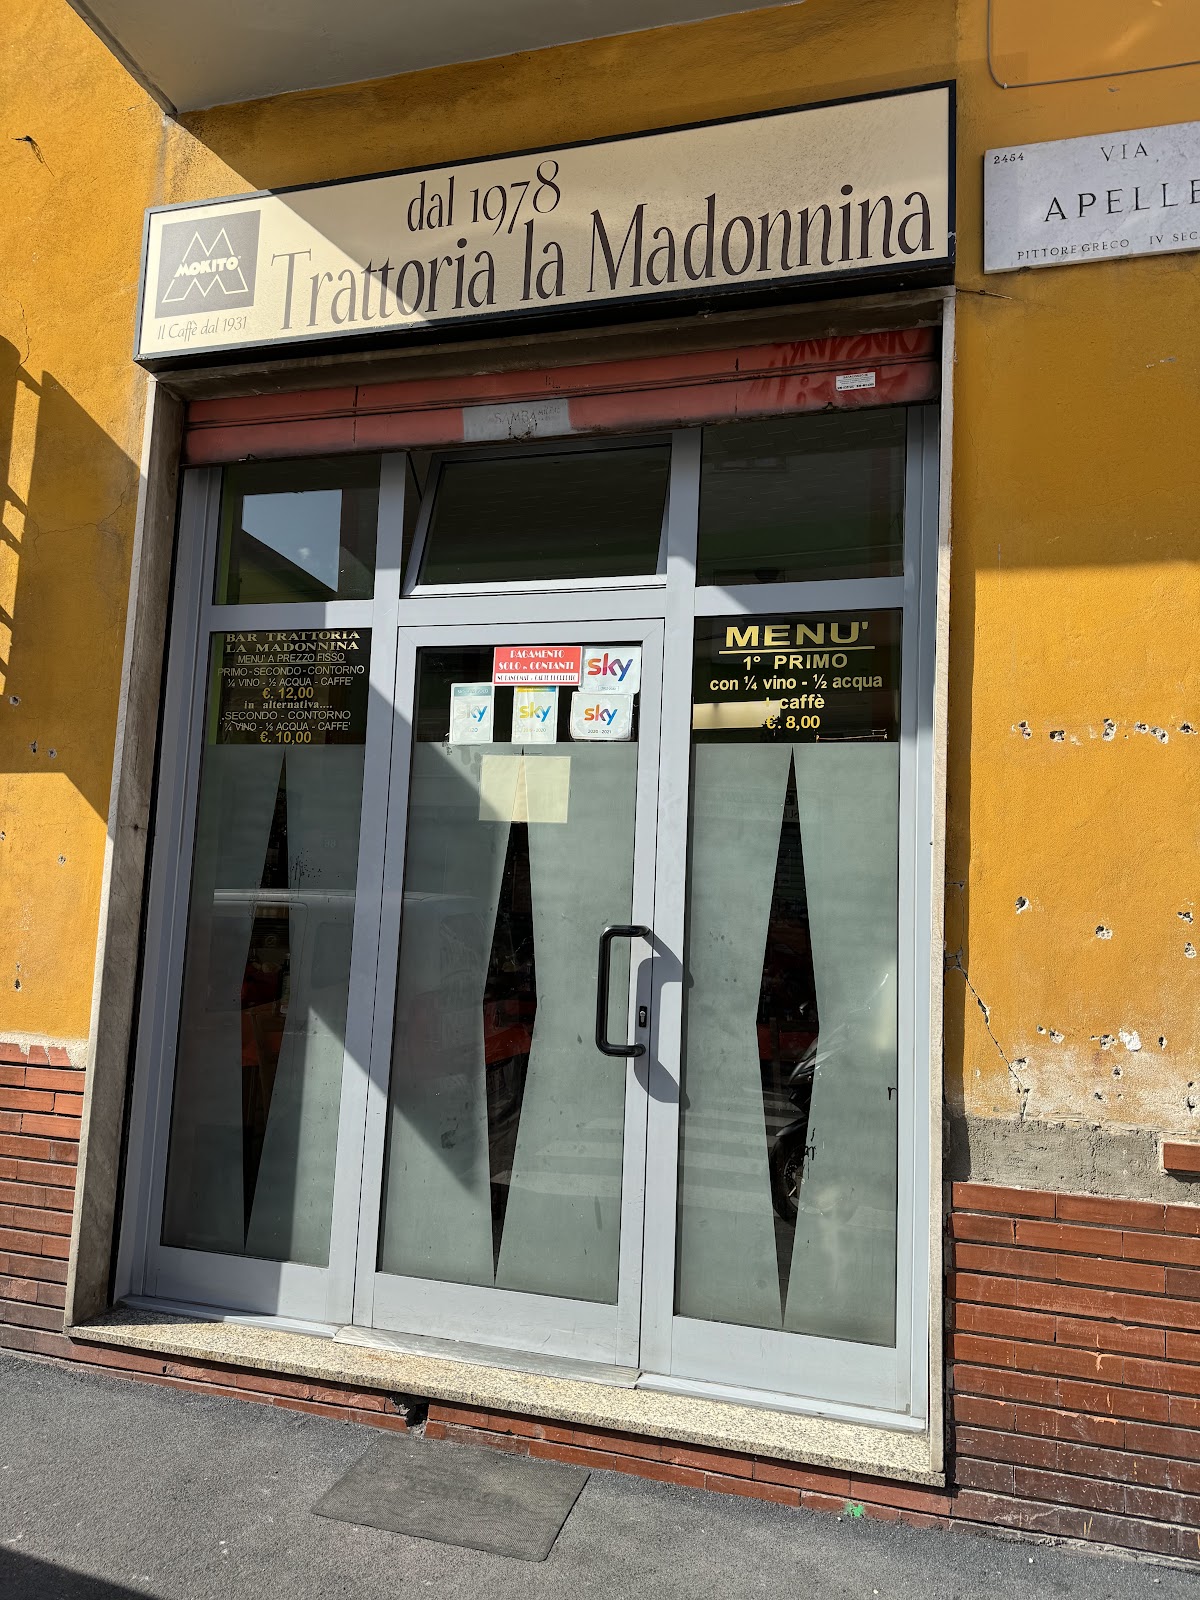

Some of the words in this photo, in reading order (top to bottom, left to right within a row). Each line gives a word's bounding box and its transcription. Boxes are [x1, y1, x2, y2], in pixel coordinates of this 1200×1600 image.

[994, 152, 1025, 165] 2454
[1100, 141, 1149, 162] VIA
[407, 175, 455, 232] dal
[470, 159, 562, 236] 1978
[1017, 244, 1077, 261] PITTORE
[1081, 238, 1131, 253] GRECO
[1149, 234, 1164, 245] IV
[270, 237, 497, 330] Trattoria
[519, 217, 566, 302] la
[586, 184, 935, 293] Madonnina
[173, 256, 239, 278] MOKITO
[157, 323, 166, 341] Il
[168, 319, 198, 342] Caffè
[200, 317, 220, 336] dal
[223, 315, 248, 332] 1931
[225, 632, 258, 643] BAR
[265, 630, 361, 642] TRATTORIA
[725, 621, 869, 648] MENU'
[226, 644, 248, 653] LA
[255, 640, 360, 653] MADONNINA
[510, 649, 565, 659] PAGAMENTO
[237, 653, 266, 664] MENU'
[267, 653, 275, 663] A
[277, 653, 315, 663] PREZZO
[317, 652, 345, 663] FISSO
[498, 661, 522, 671] SOLO
[529, 661, 575, 670] CONTANTI
[743, 655, 761, 671] 1°
[774, 652, 848, 670] PRIMO
[587, 652, 634, 682] sky
[238, 678, 260, 687] VINO
[279, 677, 312, 687] ACQUA
[320, 676, 353, 686] CAFFE'
[709, 679, 739, 691] con
[763, 674, 797, 690] vino
[832, 674, 883, 692] acqua
[278, 686, 314, 700] 12,00
[780, 693, 825, 710] caffè
[244, 700, 255, 709] in
[519, 701, 552, 723] sky
[288, 710, 351, 720] CONTORNO
[584, 704, 618, 726] sky
[785, 715, 821, 732] 8,00
[275, 721, 309, 731] ACQUA
[317, 721, 351, 731] CAFFE'
[276, 731, 312, 745] 10,00
